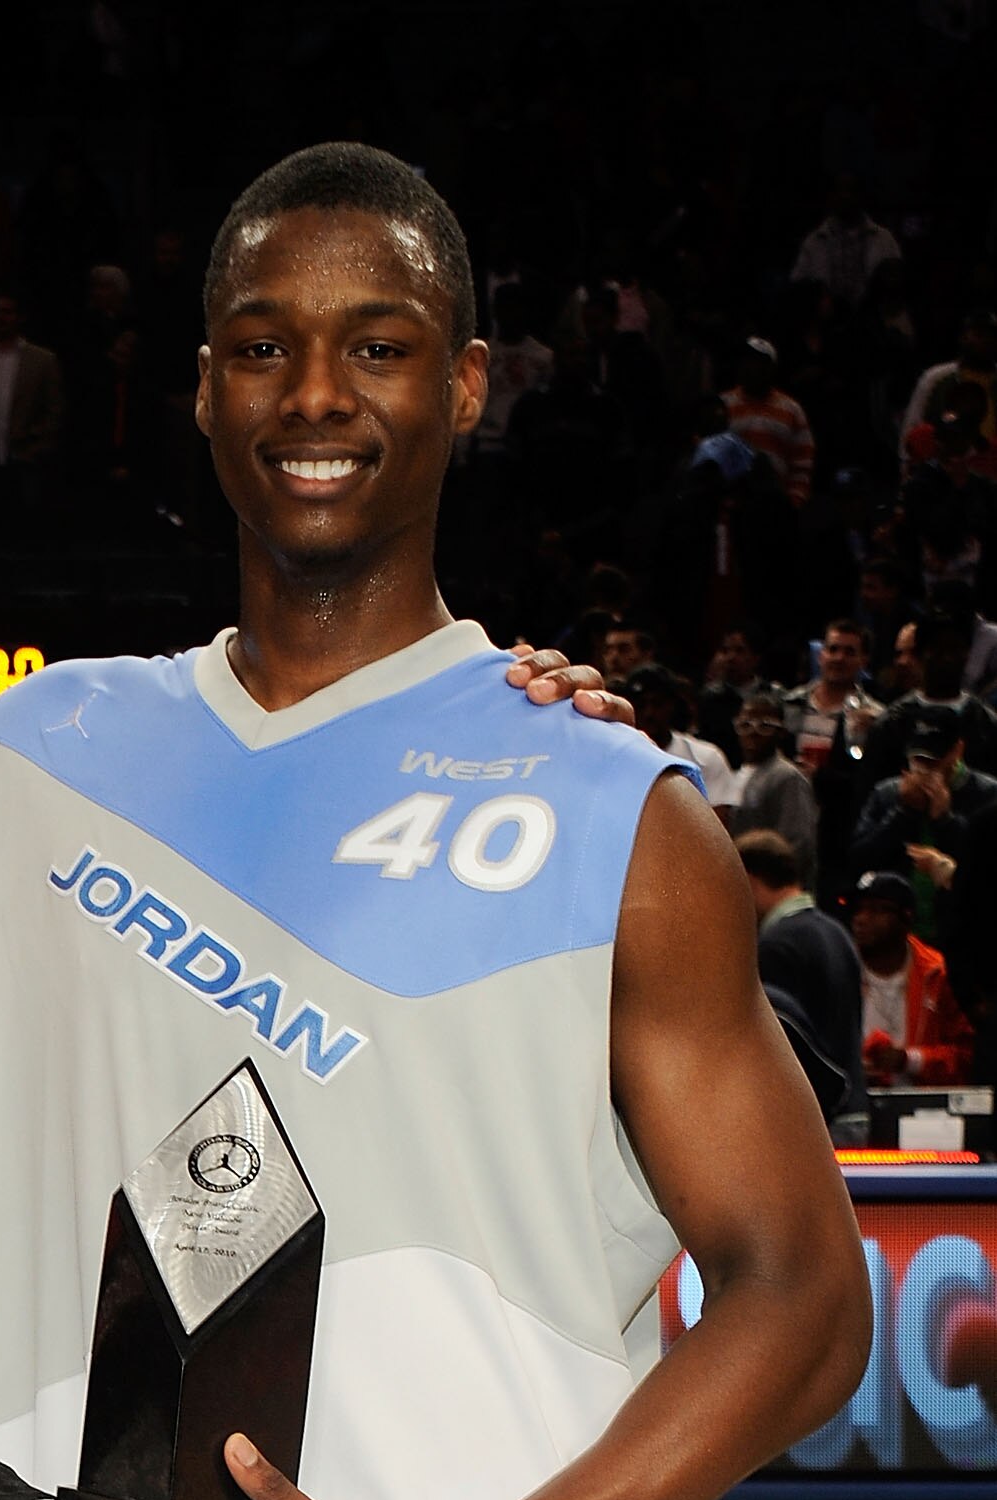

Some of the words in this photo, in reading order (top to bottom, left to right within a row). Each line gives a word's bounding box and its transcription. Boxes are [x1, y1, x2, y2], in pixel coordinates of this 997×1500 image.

[398, 747, 550, 781] WEST
[331, 791, 557, 893] 40
[47, 844, 369, 1086] JORDAN
